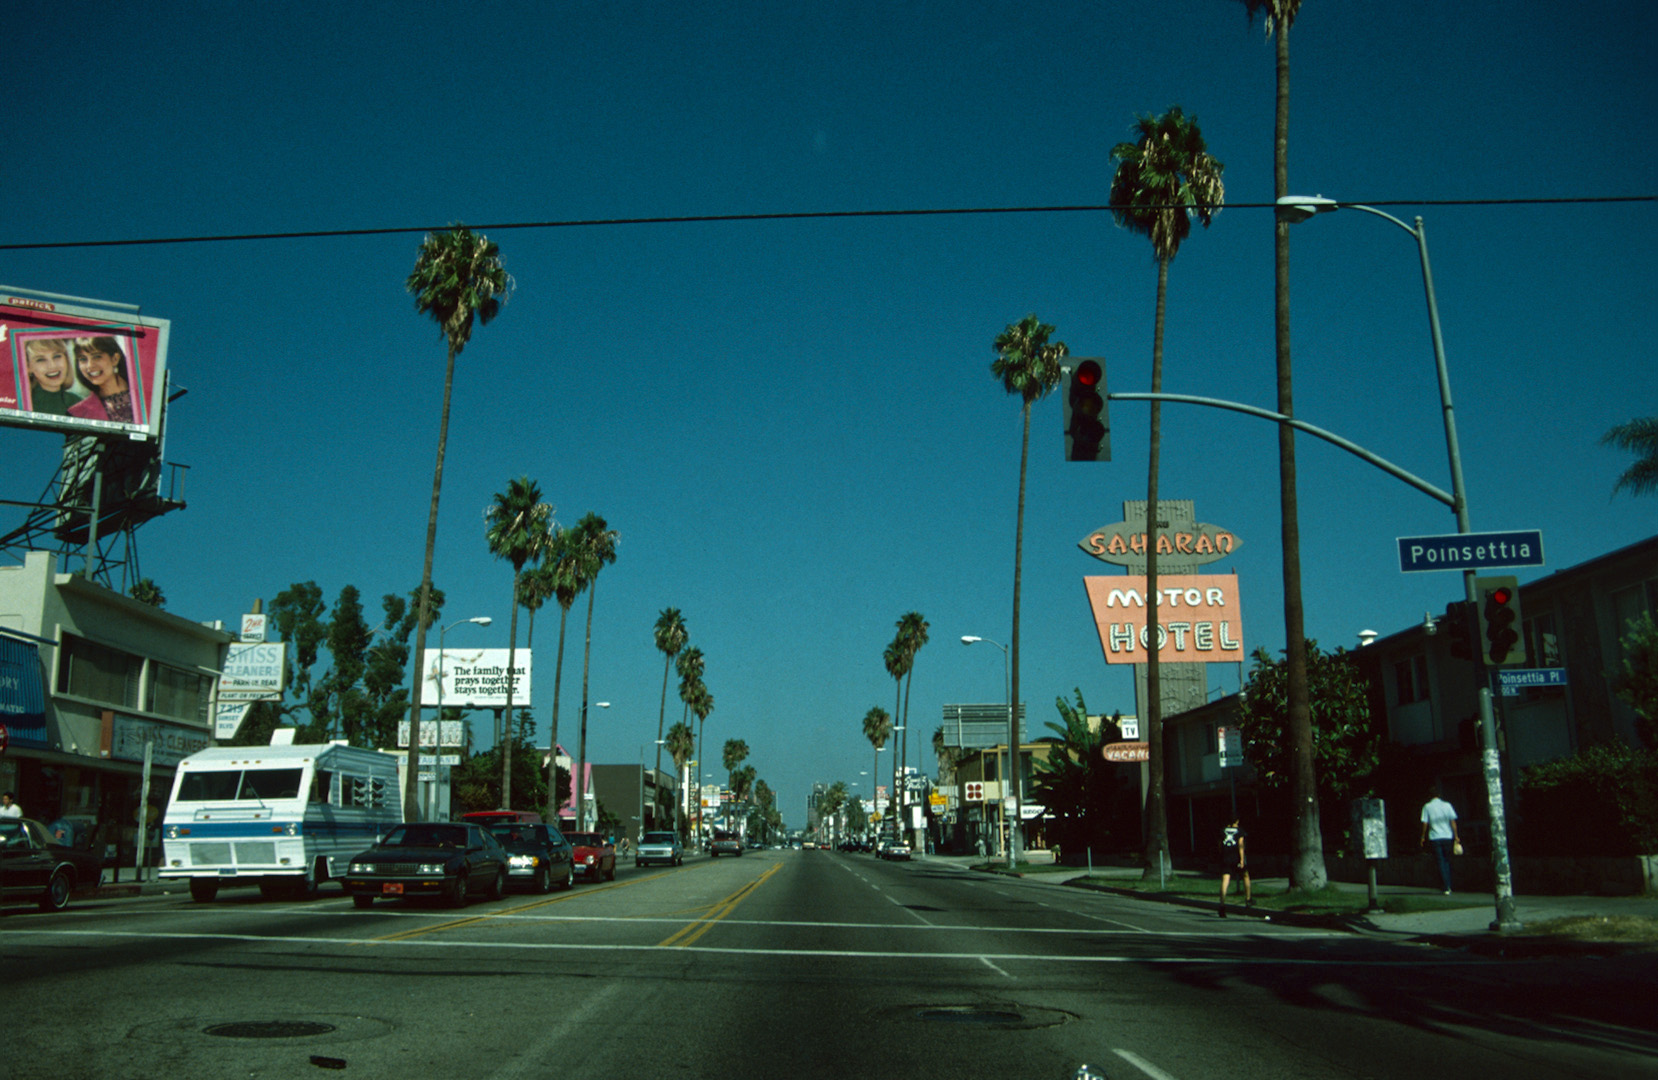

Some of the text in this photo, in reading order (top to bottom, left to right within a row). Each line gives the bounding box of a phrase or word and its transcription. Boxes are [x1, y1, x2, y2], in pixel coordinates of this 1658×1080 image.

[11, 298, 53, 311] patrick
[1411, 541, 1531, 564] Poinsettia
[1109, 620, 1240, 653] HOTEL
[227, 647, 277, 664] SWISS
[224, 666, 281, 676] CLEANERS
[454, 666, 471, 676] The
[473, 666, 504, 677] family
[455, 677, 480, 686] prays
[454, 685, 520, 695] stays togethr.
[219, 704, 244, 714] 7219
[135, 725, 164, 748] SWISS
[1125, 727, 1136, 737] TV
